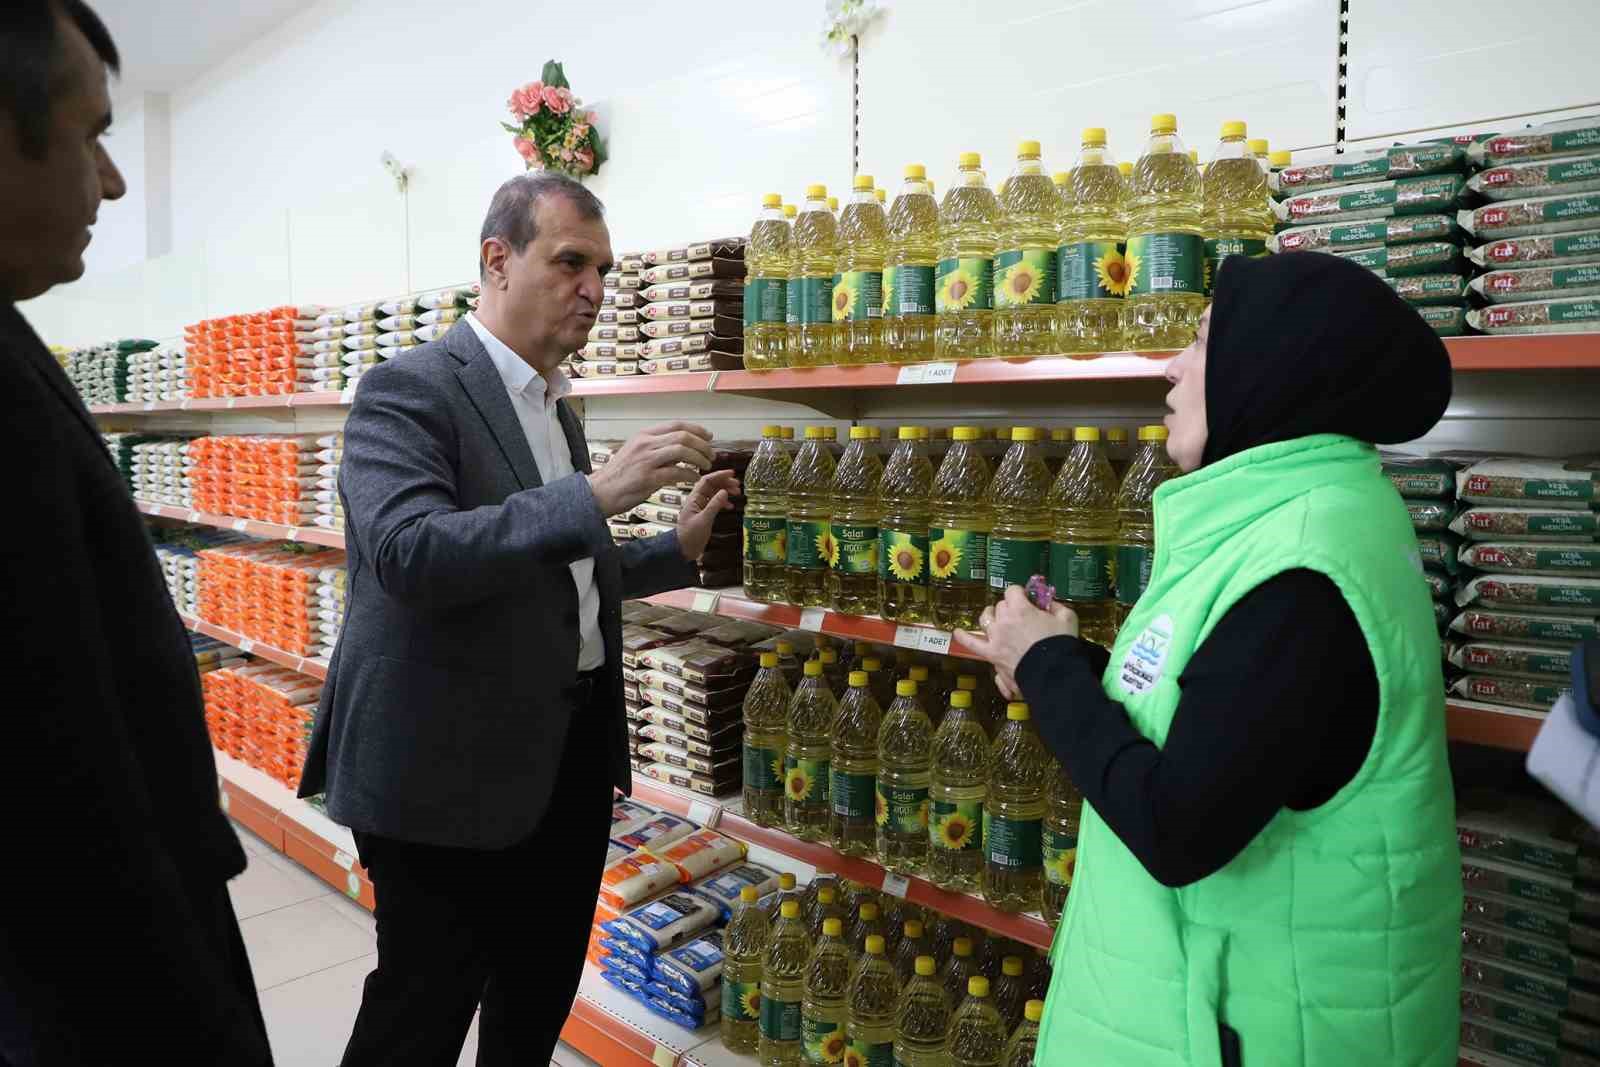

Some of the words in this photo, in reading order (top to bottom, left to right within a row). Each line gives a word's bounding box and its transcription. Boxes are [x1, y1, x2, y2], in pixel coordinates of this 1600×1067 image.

[1215, 241, 1244, 254] Salat
[842, 528, 865, 539] Salat
[928, 636, 948, 646] ADET
